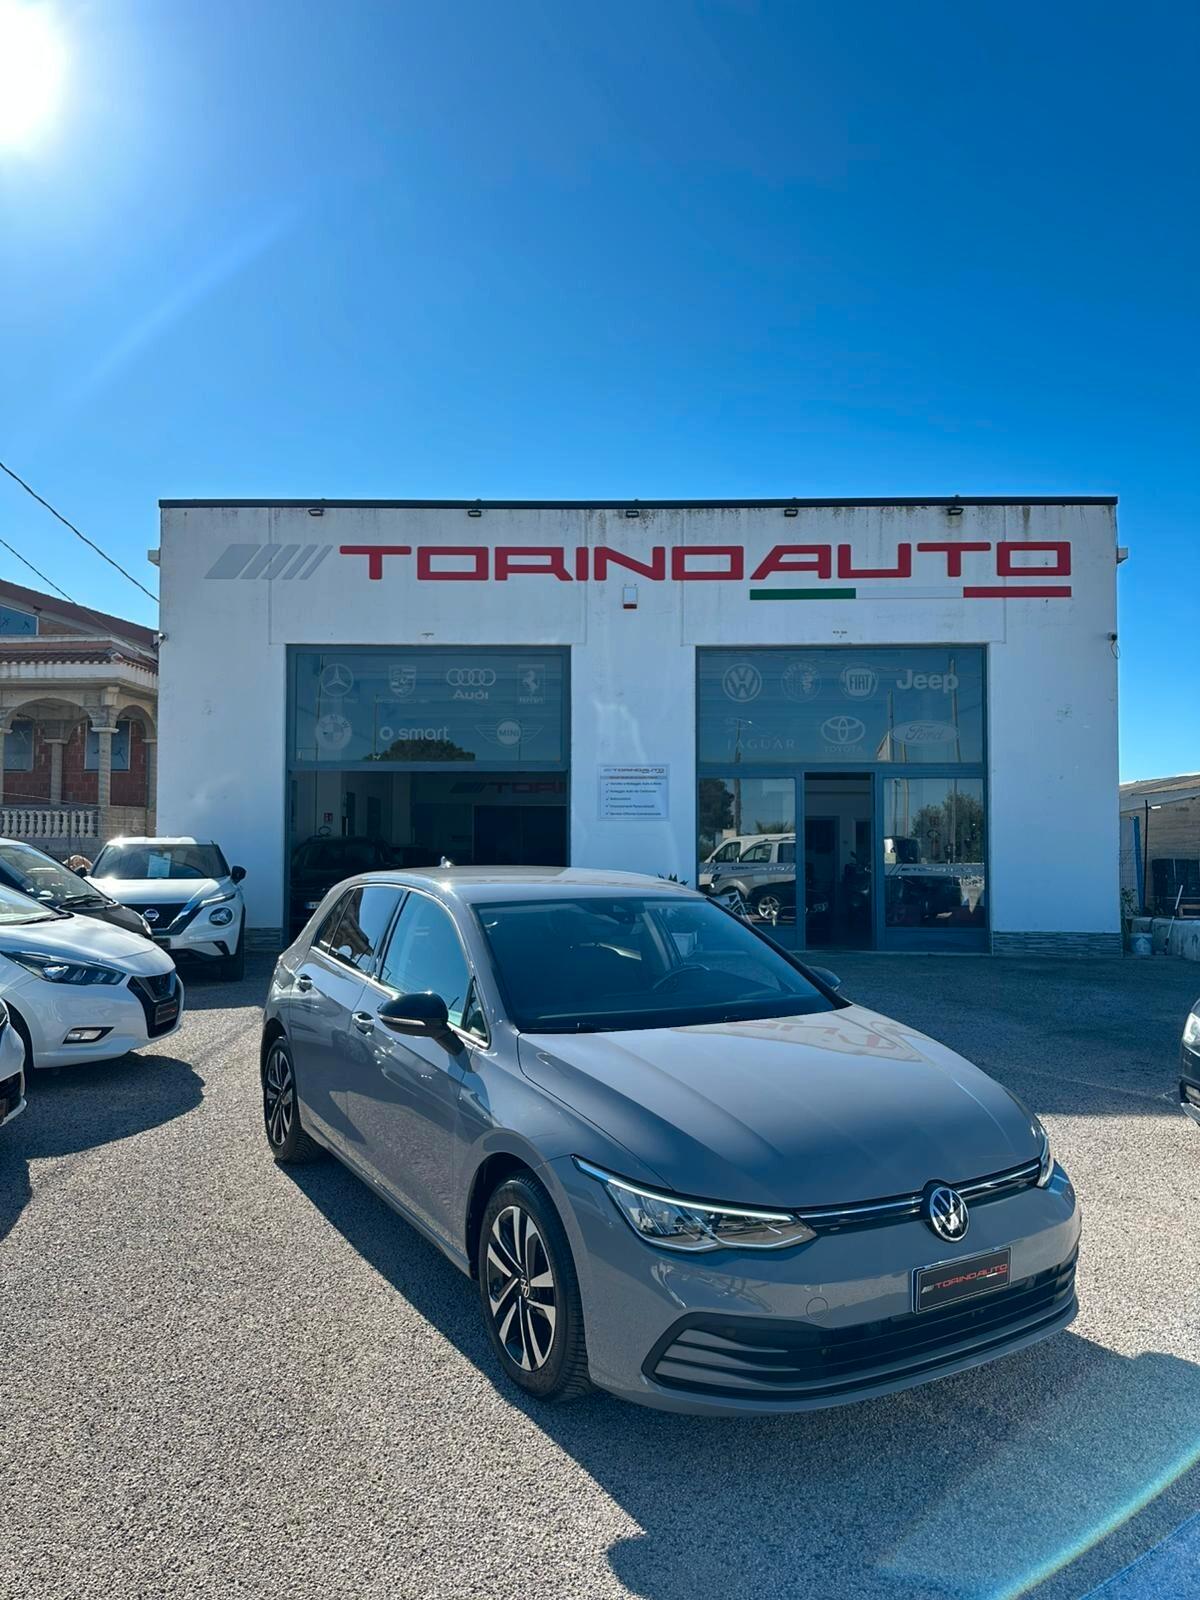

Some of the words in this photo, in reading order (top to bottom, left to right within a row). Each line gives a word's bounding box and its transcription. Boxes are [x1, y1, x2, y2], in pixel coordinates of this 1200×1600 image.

[339, 540, 1072, 582] TORINOAUTO
[849, 675, 871, 690] FIAT
[896, 669, 959, 694] Jeep
[453, 690, 489, 701] Audi
[398, 726, 450, 741] smart
[502, 727, 521, 737] MINI
[824, 745, 864, 753] TOYOTA
[935, 1263, 1009, 1288] TORINOAUTO
